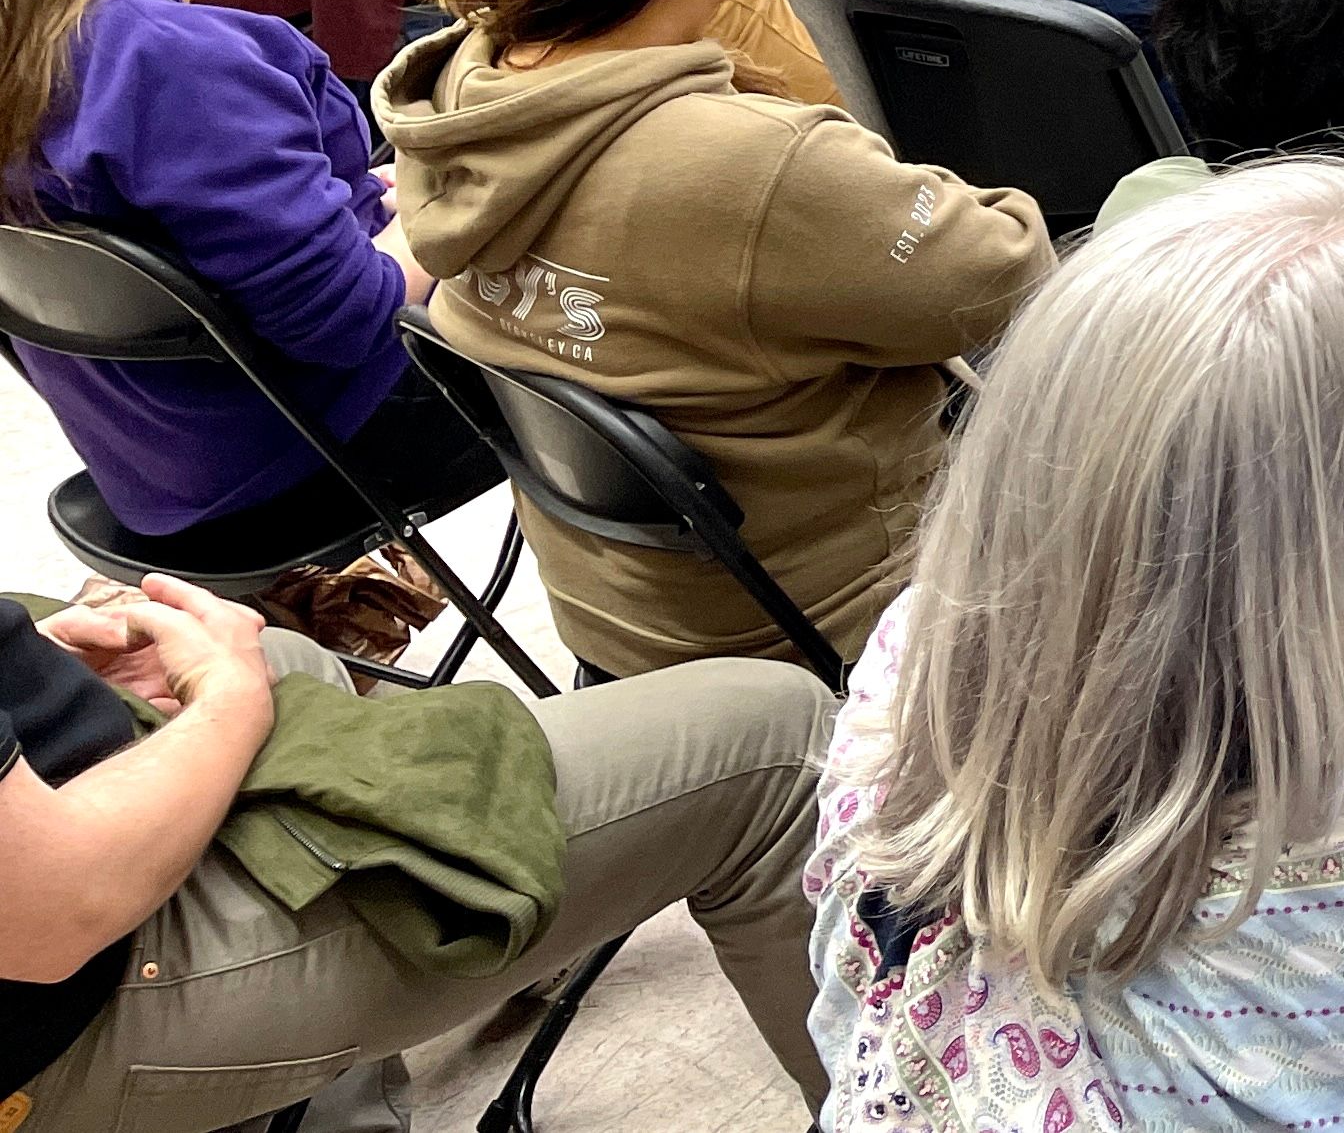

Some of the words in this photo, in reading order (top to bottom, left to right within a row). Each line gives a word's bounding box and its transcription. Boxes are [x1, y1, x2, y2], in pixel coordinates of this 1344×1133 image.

[890, 230, 925, 264] EST.
[910, 184, 936, 226] 2023
[572, 344, 593, 362] CA
